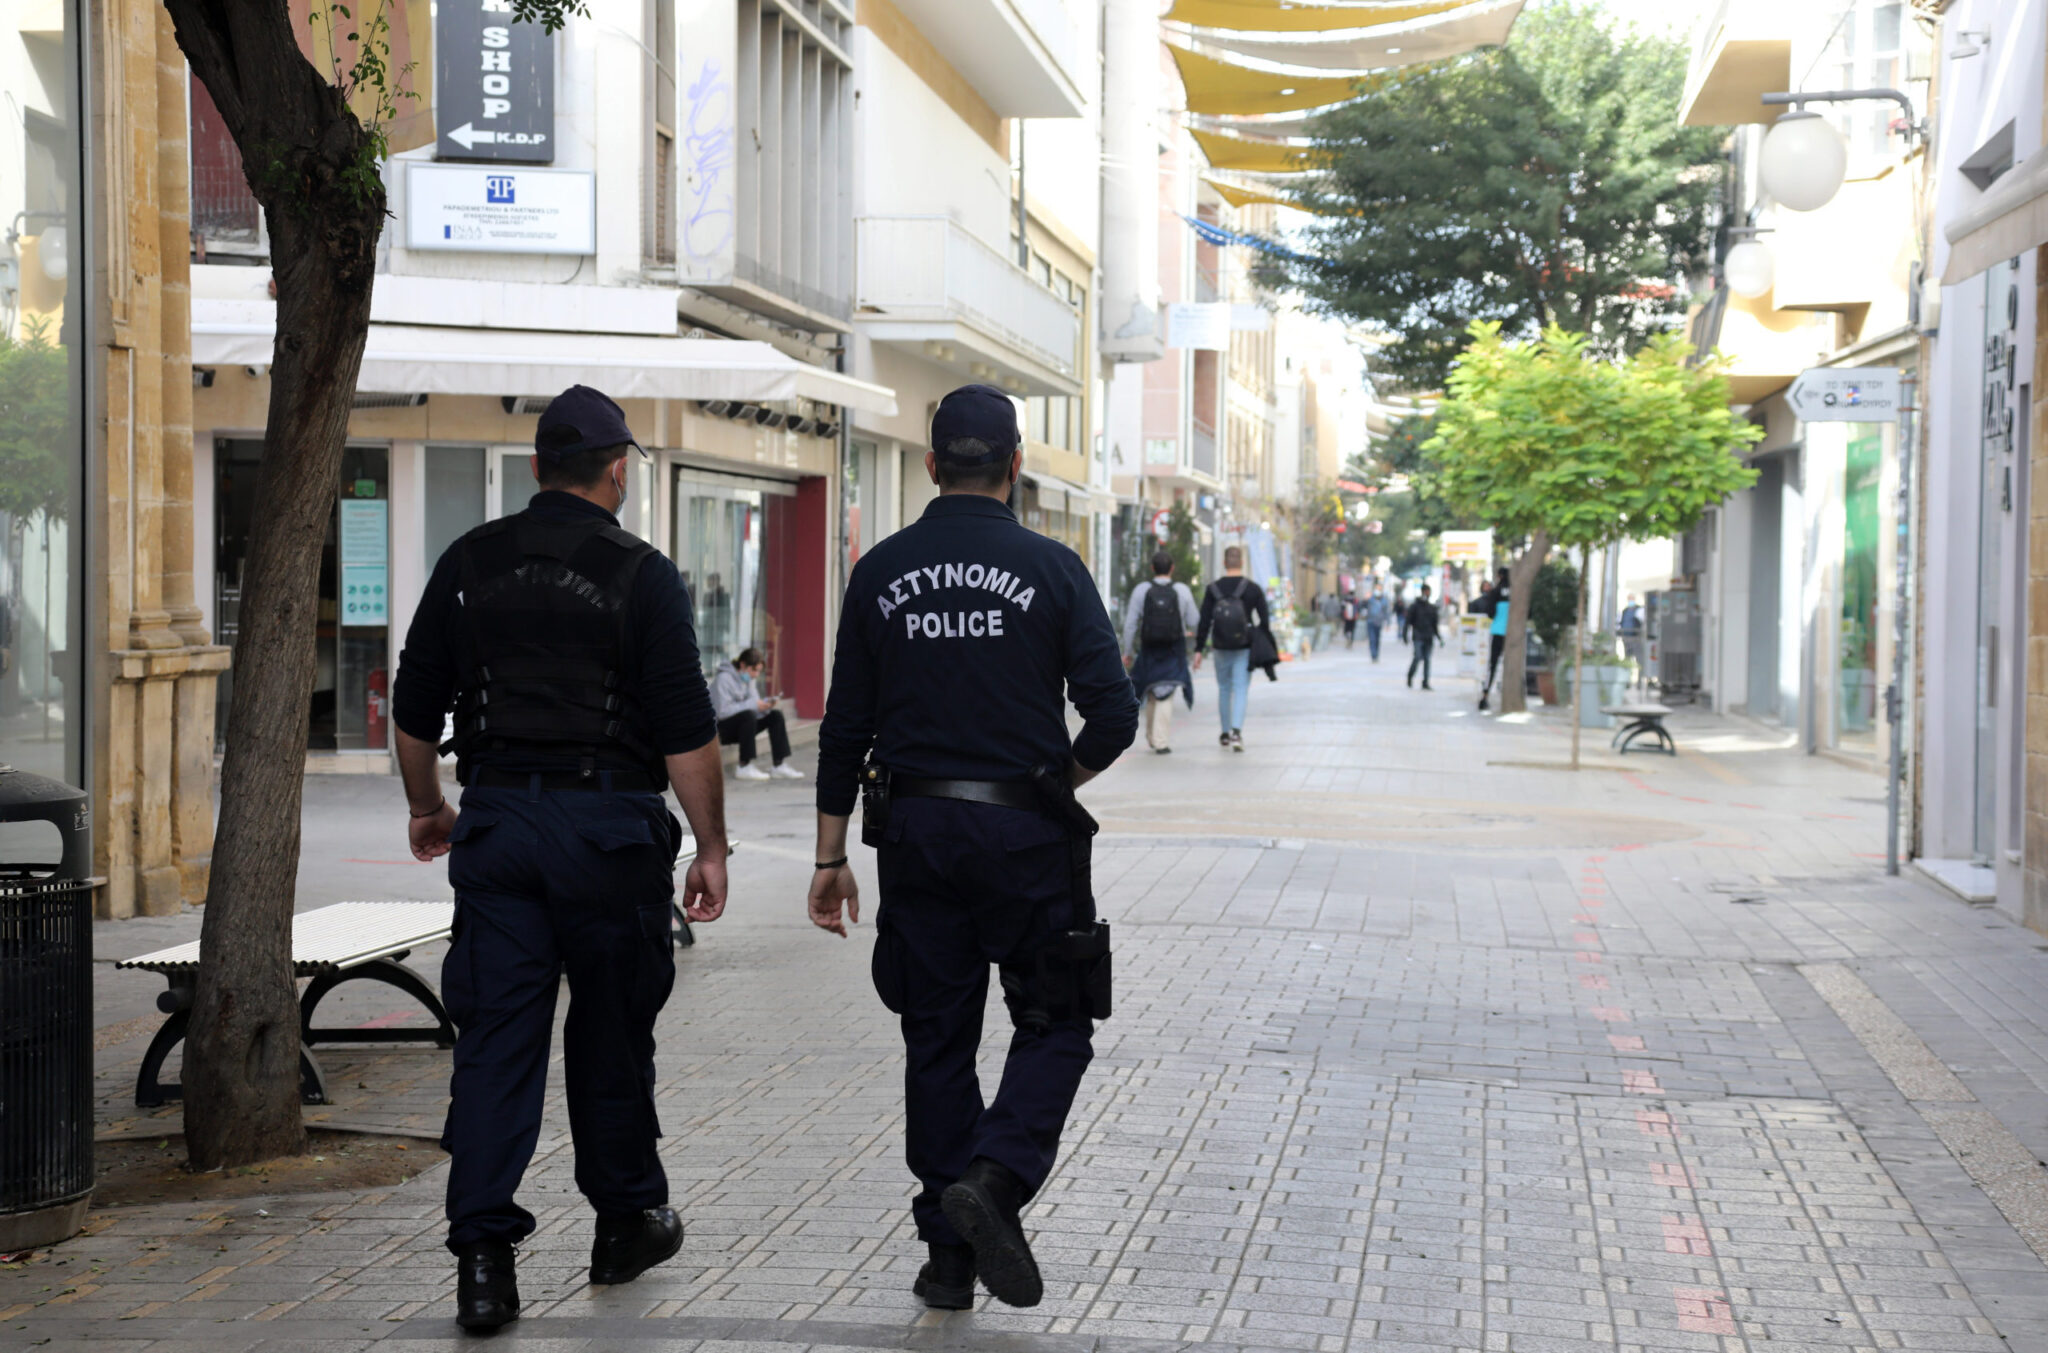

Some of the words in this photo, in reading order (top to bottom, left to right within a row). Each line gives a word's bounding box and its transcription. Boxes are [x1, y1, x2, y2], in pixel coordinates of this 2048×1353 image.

[481, 26, 511, 119] SHOP
[496, 131, 546, 145] K.D.P
[510, 207, 545, 215] PARTNERS
[877, 563, 1036, 620] ΑΣΤΥΝΟΜΙΑ
[905, 609, 1004, 640] POLICE
